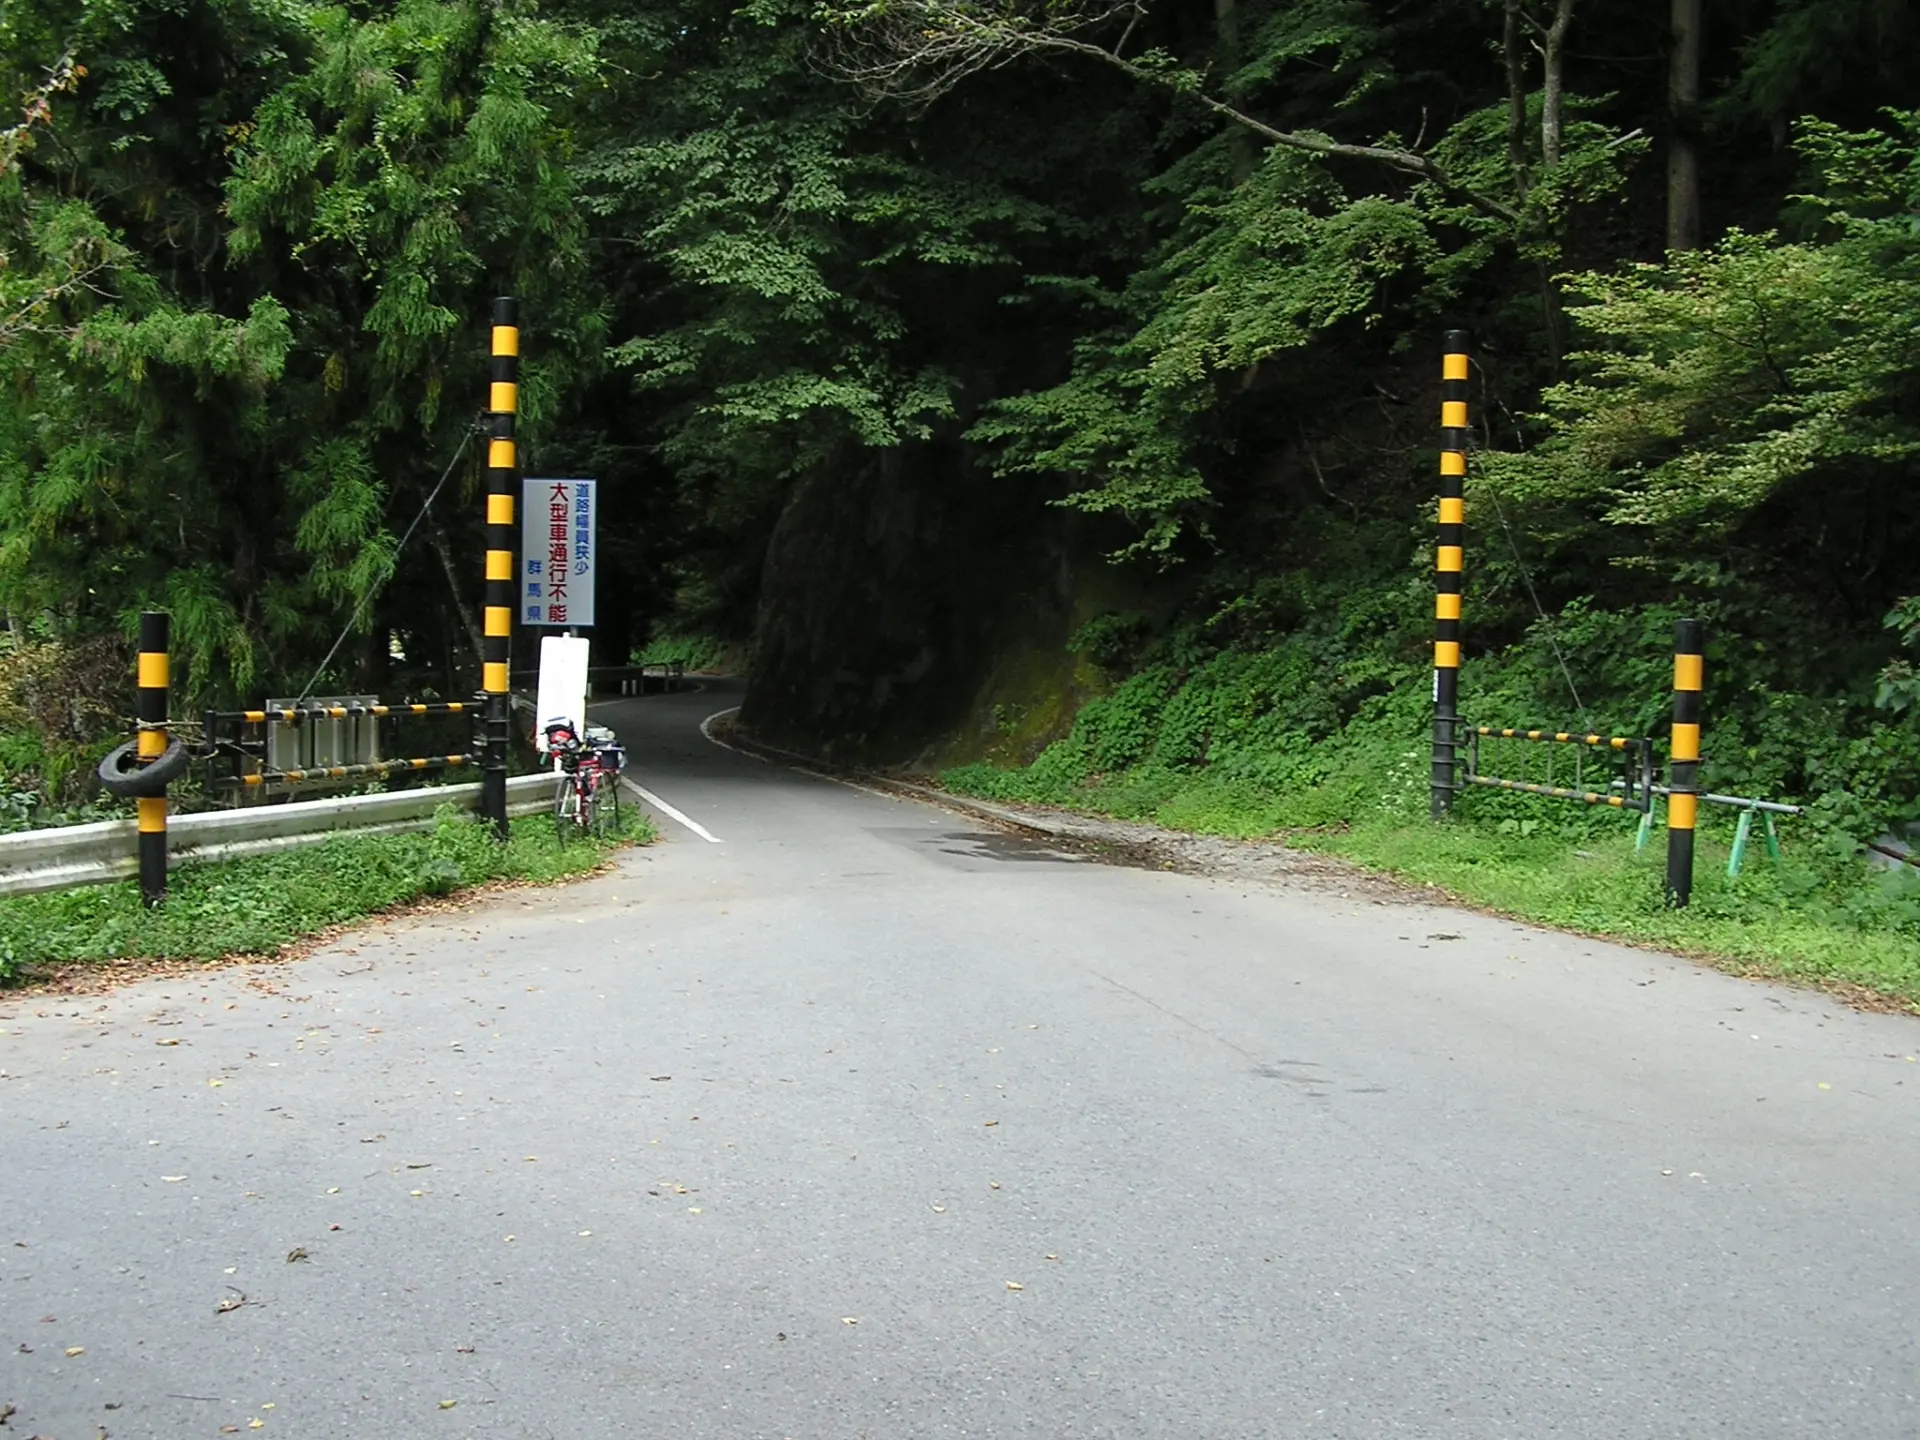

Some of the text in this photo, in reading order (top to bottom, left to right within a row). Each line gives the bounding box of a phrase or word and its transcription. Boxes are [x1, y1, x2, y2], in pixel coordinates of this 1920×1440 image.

[527, 559, 542, 621] 群馬県
[548, 482, 569, 622] 大型車通行不能
